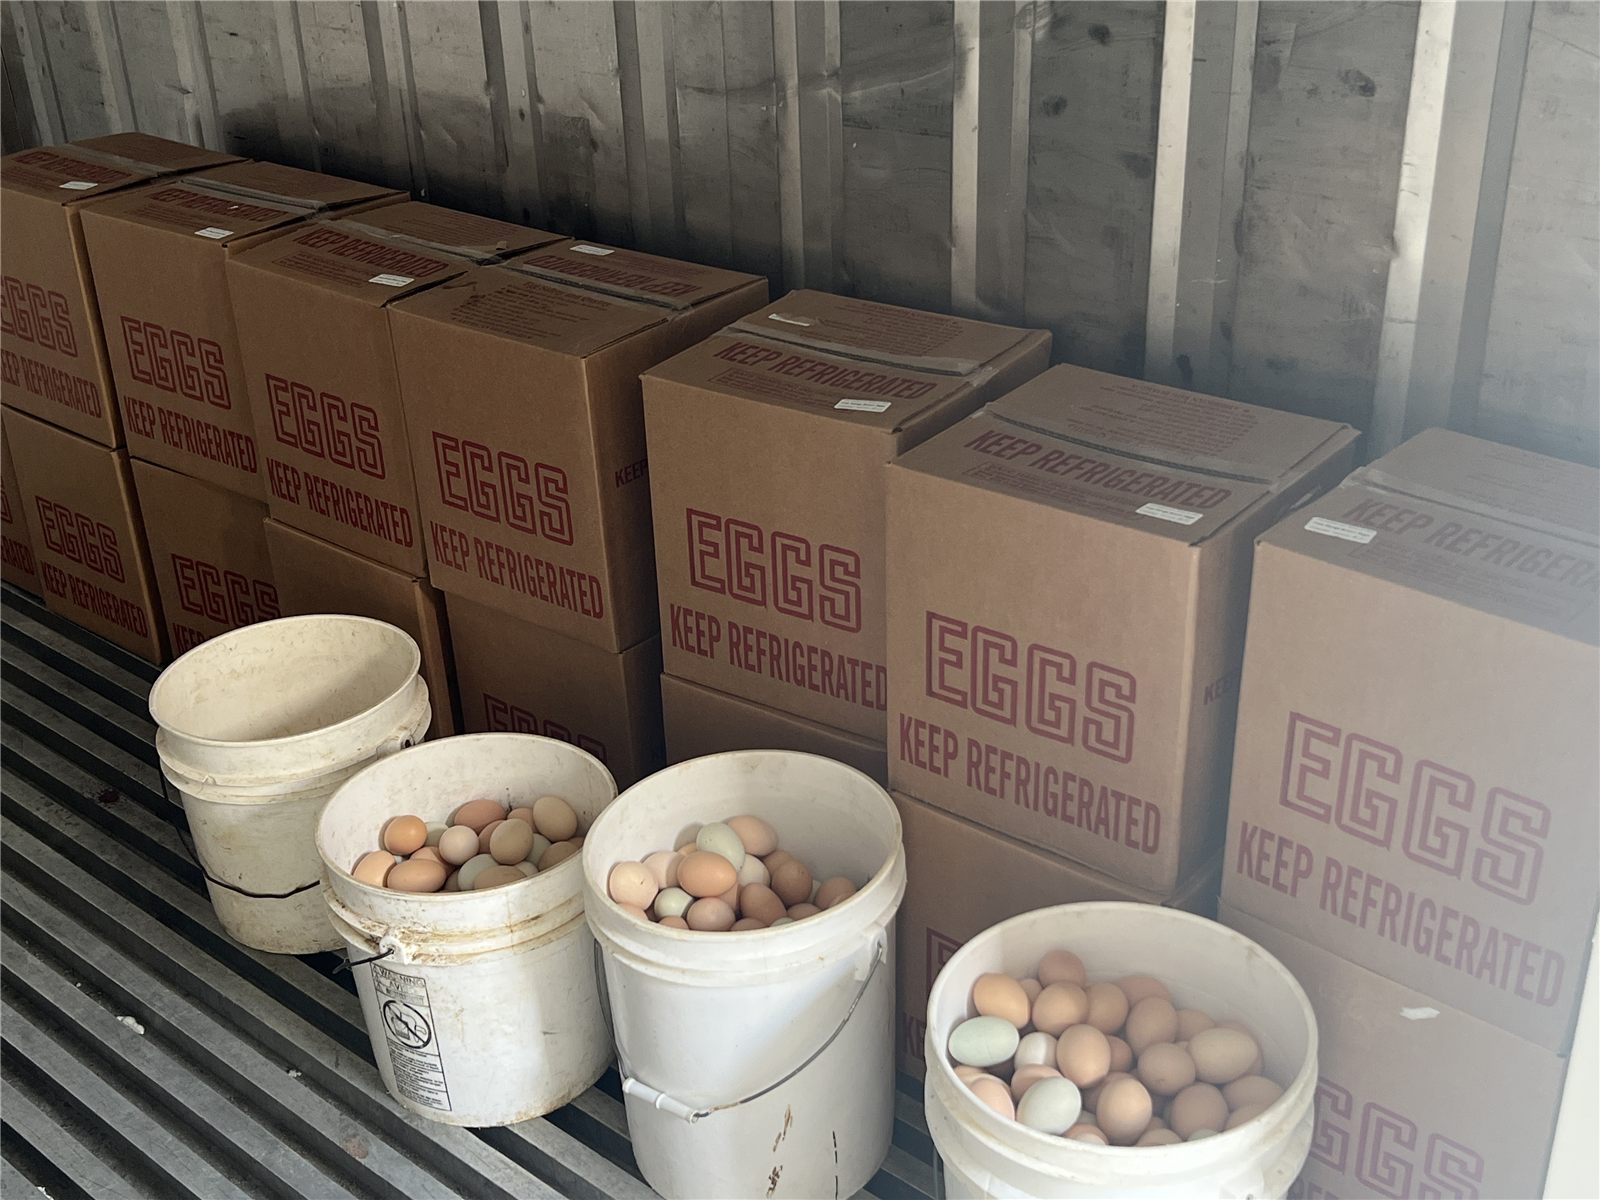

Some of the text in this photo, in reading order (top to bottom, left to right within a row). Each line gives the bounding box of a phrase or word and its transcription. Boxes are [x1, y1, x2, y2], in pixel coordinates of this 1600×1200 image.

[293, 228, 350, 250] KEEP
[328, 239, 450, 278] REFRIGERATED
[0, 348, 101, 419] EEP REFRIGERATED
[120, 315, 231, 410] EGGS
[713, 341, 778, 366] KEEP
[769, 356, 938, 400] REFRIGERATED
[123, 396, 258, 474] KEEP REFRIGERATED
[265, 373, 385, 480] EGGS
[964, 430, 1044, 464] KEEP
[1034, 449, 1233, 509] REFRIGERATED
[266, 457, 414, 548] KEEP REFRIGERATED
[432, 431, 574, 546] EGGS
[1342, 498, 1436, 536] KEEP
[35, 495, 126, 583] EGGS
[430, 521, 604, 620] KEEP REFRIGERATED
[686, 507, 862, 634] EGGS
[40, 559, 149, 638] KEEP REFRIGERATED
[171, 552, 282, 627] EGGS
[670, 603, 887, 711] KEEP REFRIGERATED
[926, 609, 1136, 765] EGGS
[900, 712, 1161, 856] KEEP REFRIGERATED
[1279, 710, 1552, 906] EGGS
[1236, 820, 1566, 1008] KEEP REFRIGERATED
[1306, 1075, 1486, 1200] GGS
